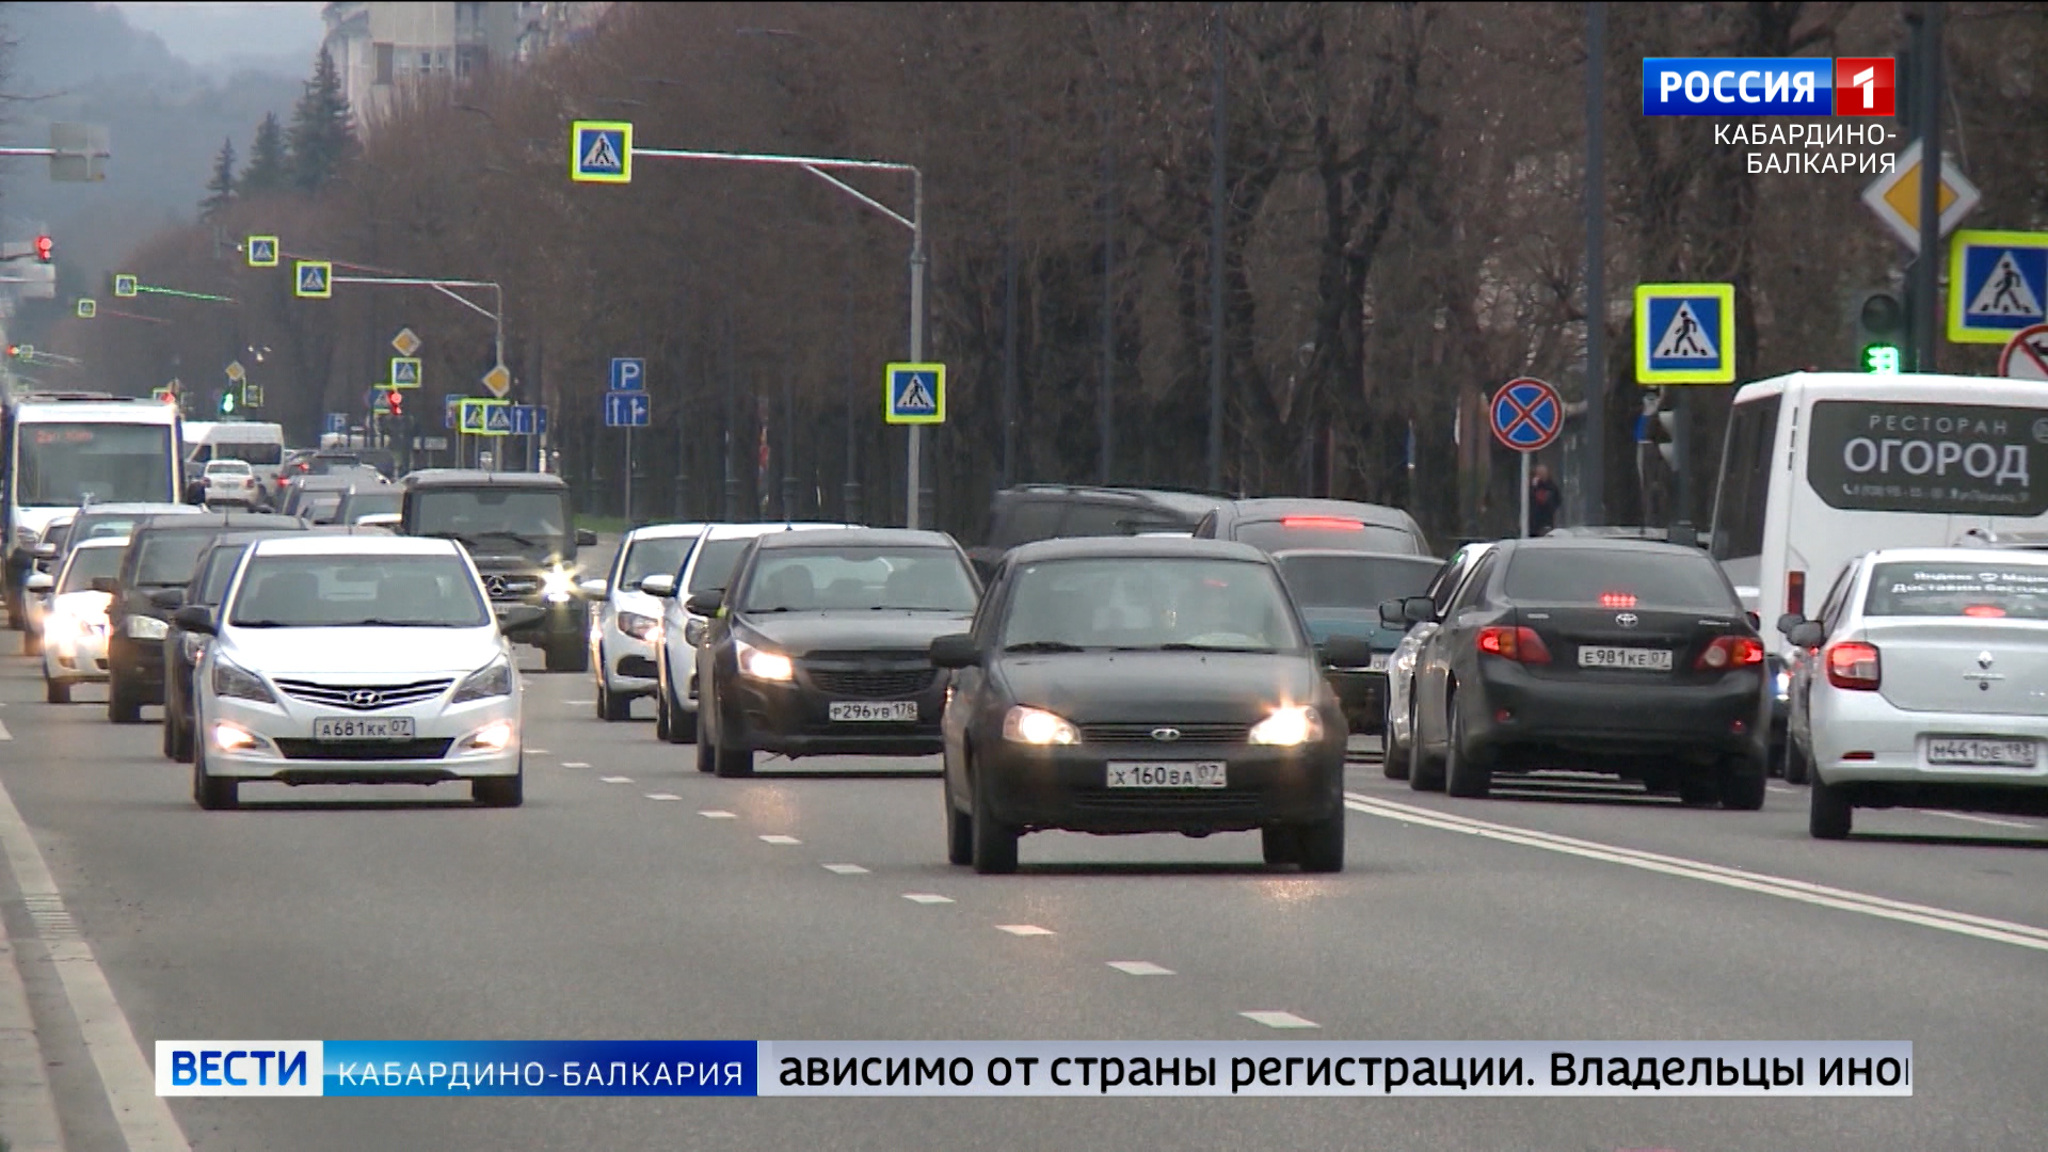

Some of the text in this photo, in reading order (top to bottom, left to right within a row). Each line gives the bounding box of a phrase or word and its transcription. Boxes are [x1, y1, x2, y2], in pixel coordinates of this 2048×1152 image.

[621, 361, 640, 388] P
[1869, 414, 2008, 435] РЕСТОРАН
[1843, 437, 2030, 487] ОГОРОД
